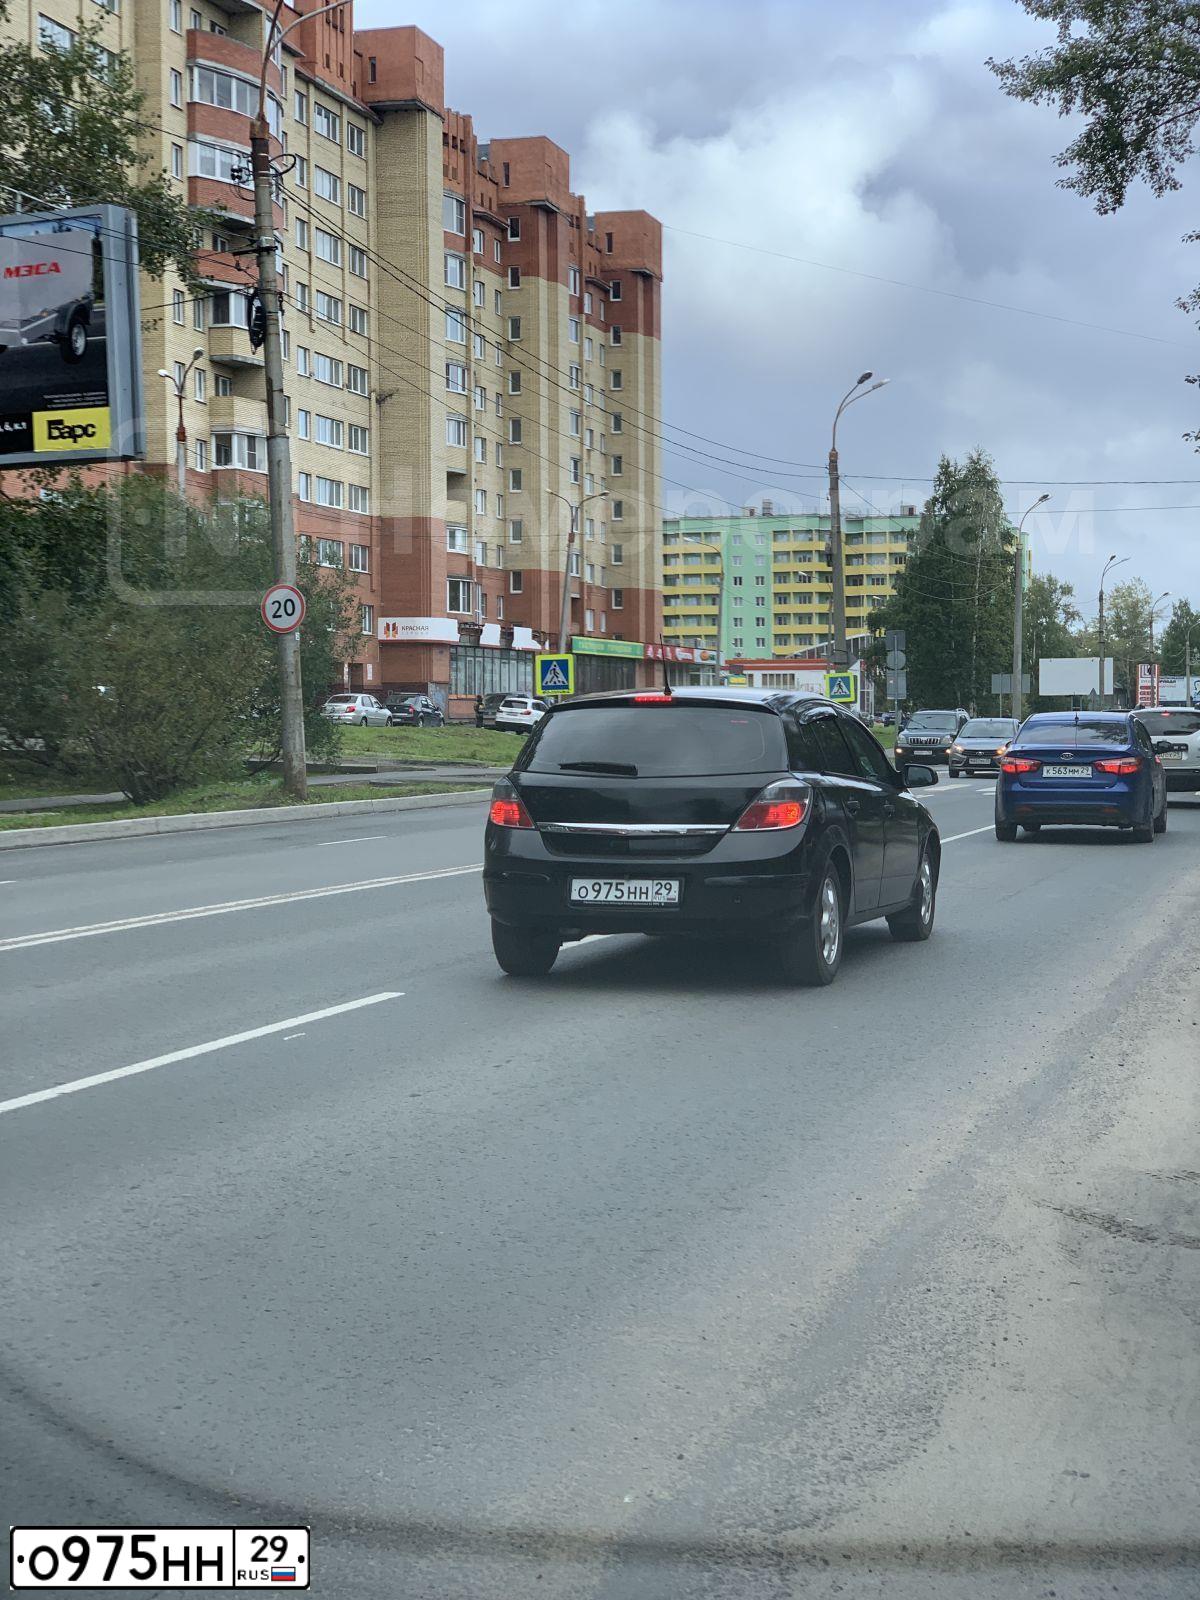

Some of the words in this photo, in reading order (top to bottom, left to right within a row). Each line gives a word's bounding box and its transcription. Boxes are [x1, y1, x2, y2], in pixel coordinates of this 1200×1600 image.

[46, 419, 97, 443] Барс
[271, 598, 296, 618] 20
[654, 882, 673, 896] 29
